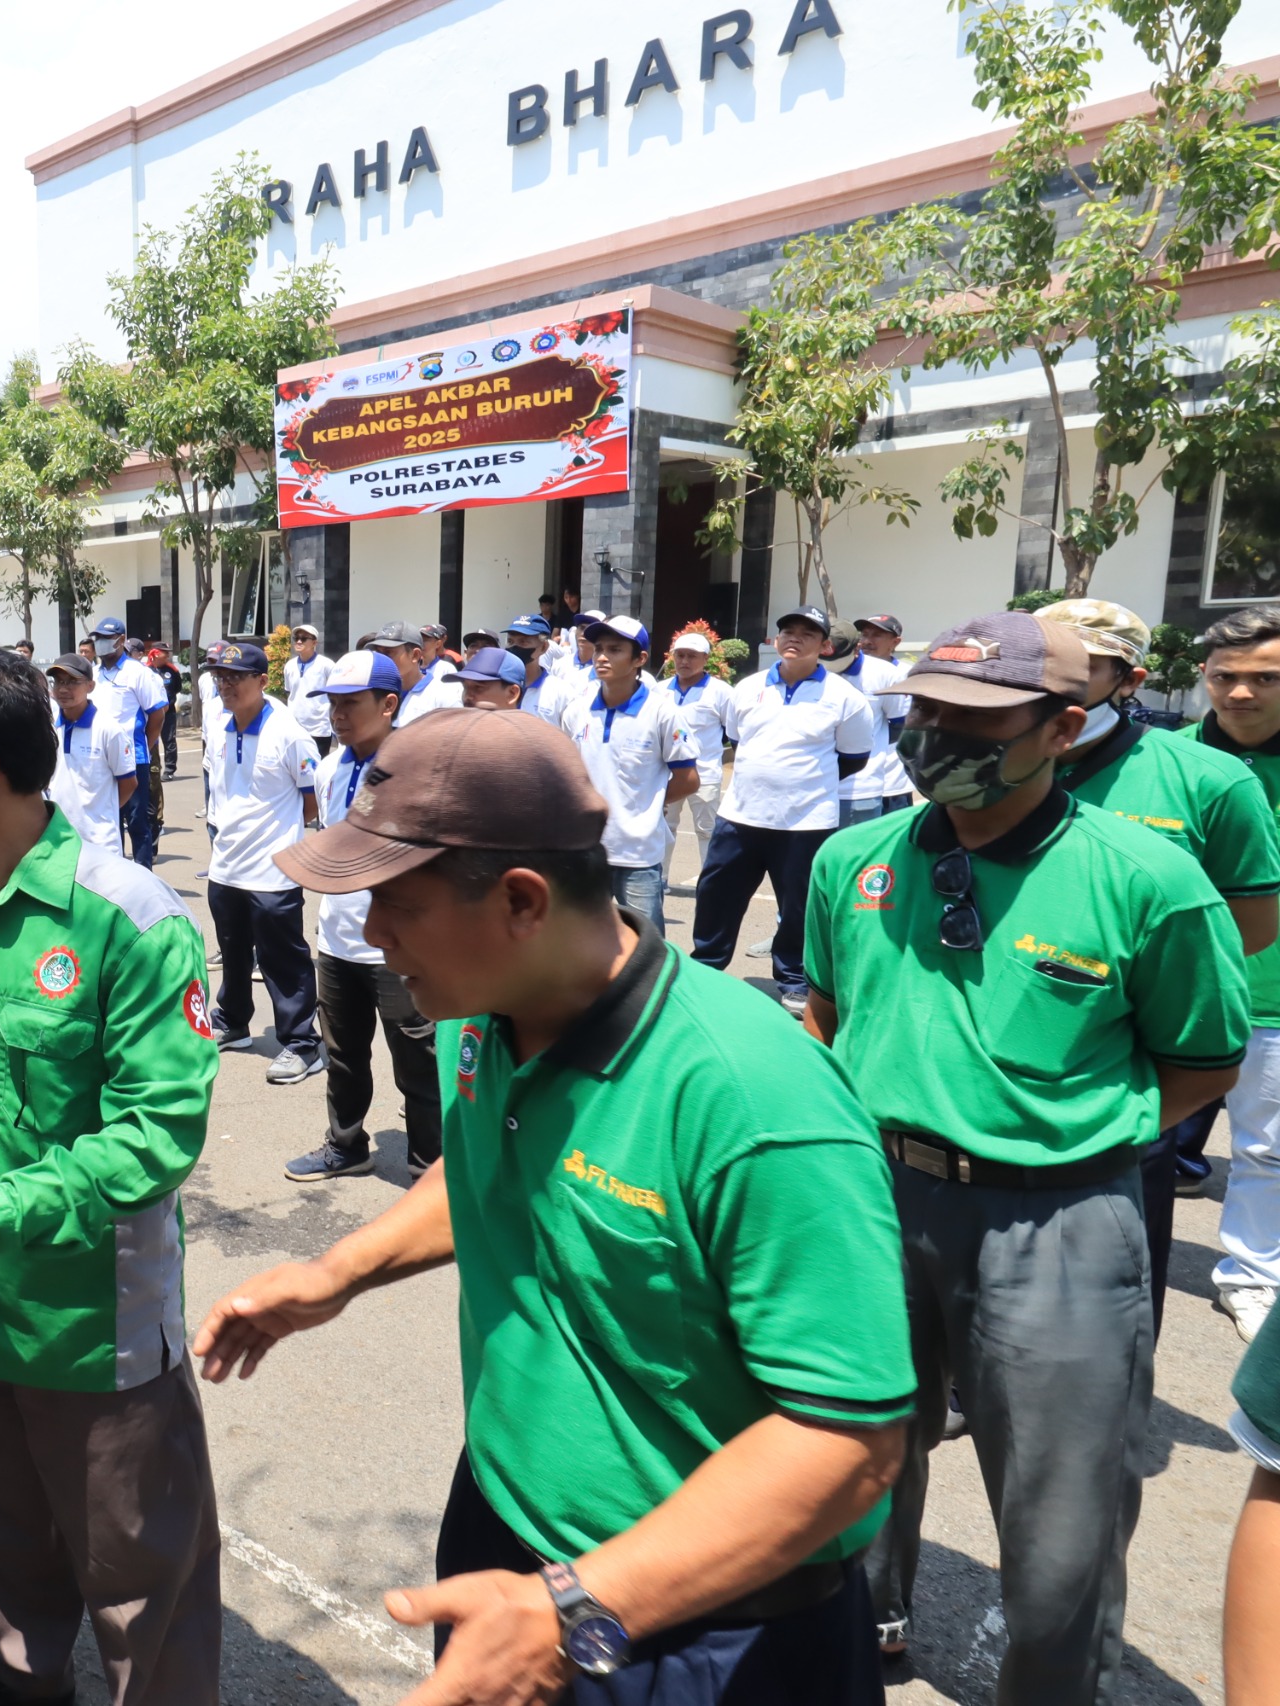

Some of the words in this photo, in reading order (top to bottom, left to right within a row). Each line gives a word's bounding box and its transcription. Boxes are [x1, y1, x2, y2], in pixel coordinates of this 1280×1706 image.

[220, 126, 440, 236] RAHA
[506, 0, 844, 147] BHARA
[365, 369, 399, 385] FSPMI
[359, 396, 417, 417] APEL
[424, 377, 510, 406] AKBAR
[312, 406, 468, 444] KEBANGSAAN
[476, 387, 573, 417] BURUH
[404, 428, 461, 449] 2025
[349, 451, 526, 484] POLRESTABES
[370, 473, 501, 498] SURABAYA
